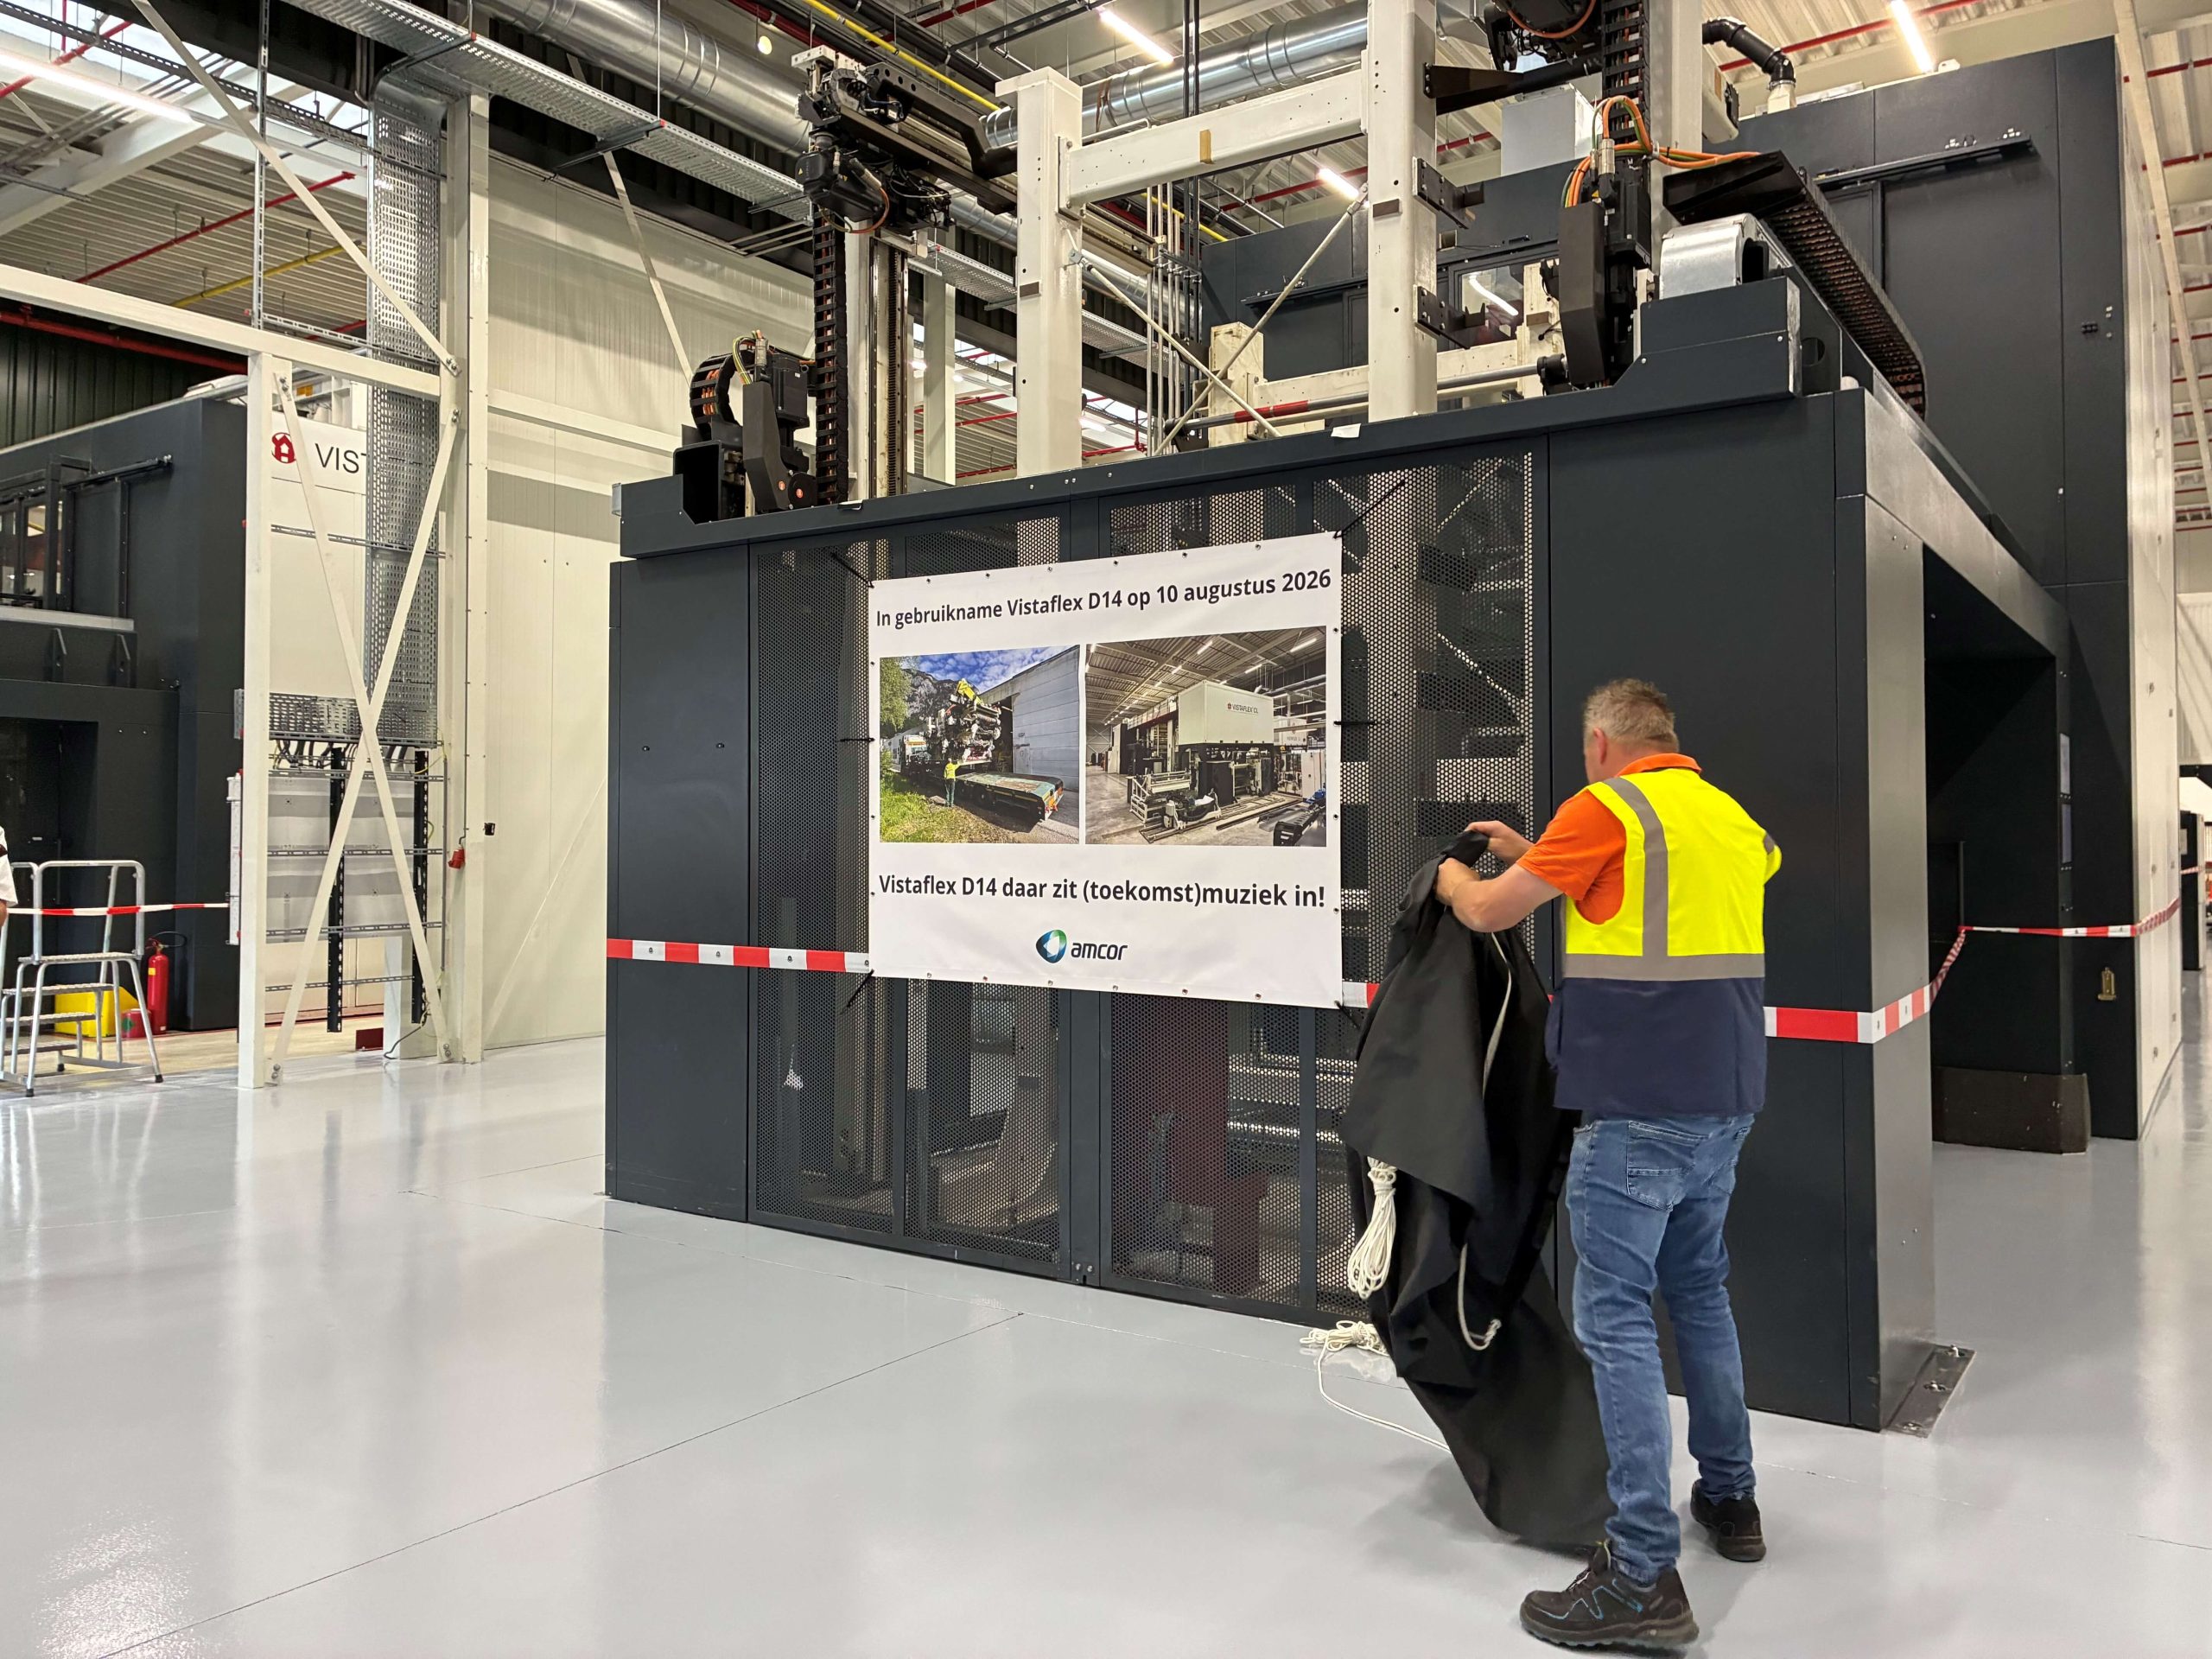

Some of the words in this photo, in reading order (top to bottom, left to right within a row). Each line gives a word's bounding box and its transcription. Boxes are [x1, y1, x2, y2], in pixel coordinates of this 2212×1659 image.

[315, 442, 366, 474] VIS
[877, 610, 891, 626] In
[894, 604, 1002, 630] gebruikname
[1007, 594, 1084, 616] Vistaflex
[1088, 589, 1122, 610] D14
[1127, 591, 1151, 611] op
[1156, 584, 1179, 604] 10
[1184, 578, 1276, 605] augustus
[1281, 569, 1332, 592] 2026
[879, 874, 957, 895] Vistaflex
[962, 877, 997, 896] D14
[1002, 876, 1047, 898] daar
[1052, 878, 1077, 899] zit
[1083, 880, 1287, 907] (toekomst)muziek
[1295, 884, 1325, 907] in!
[1071, 942, 1128, 961] amcor
